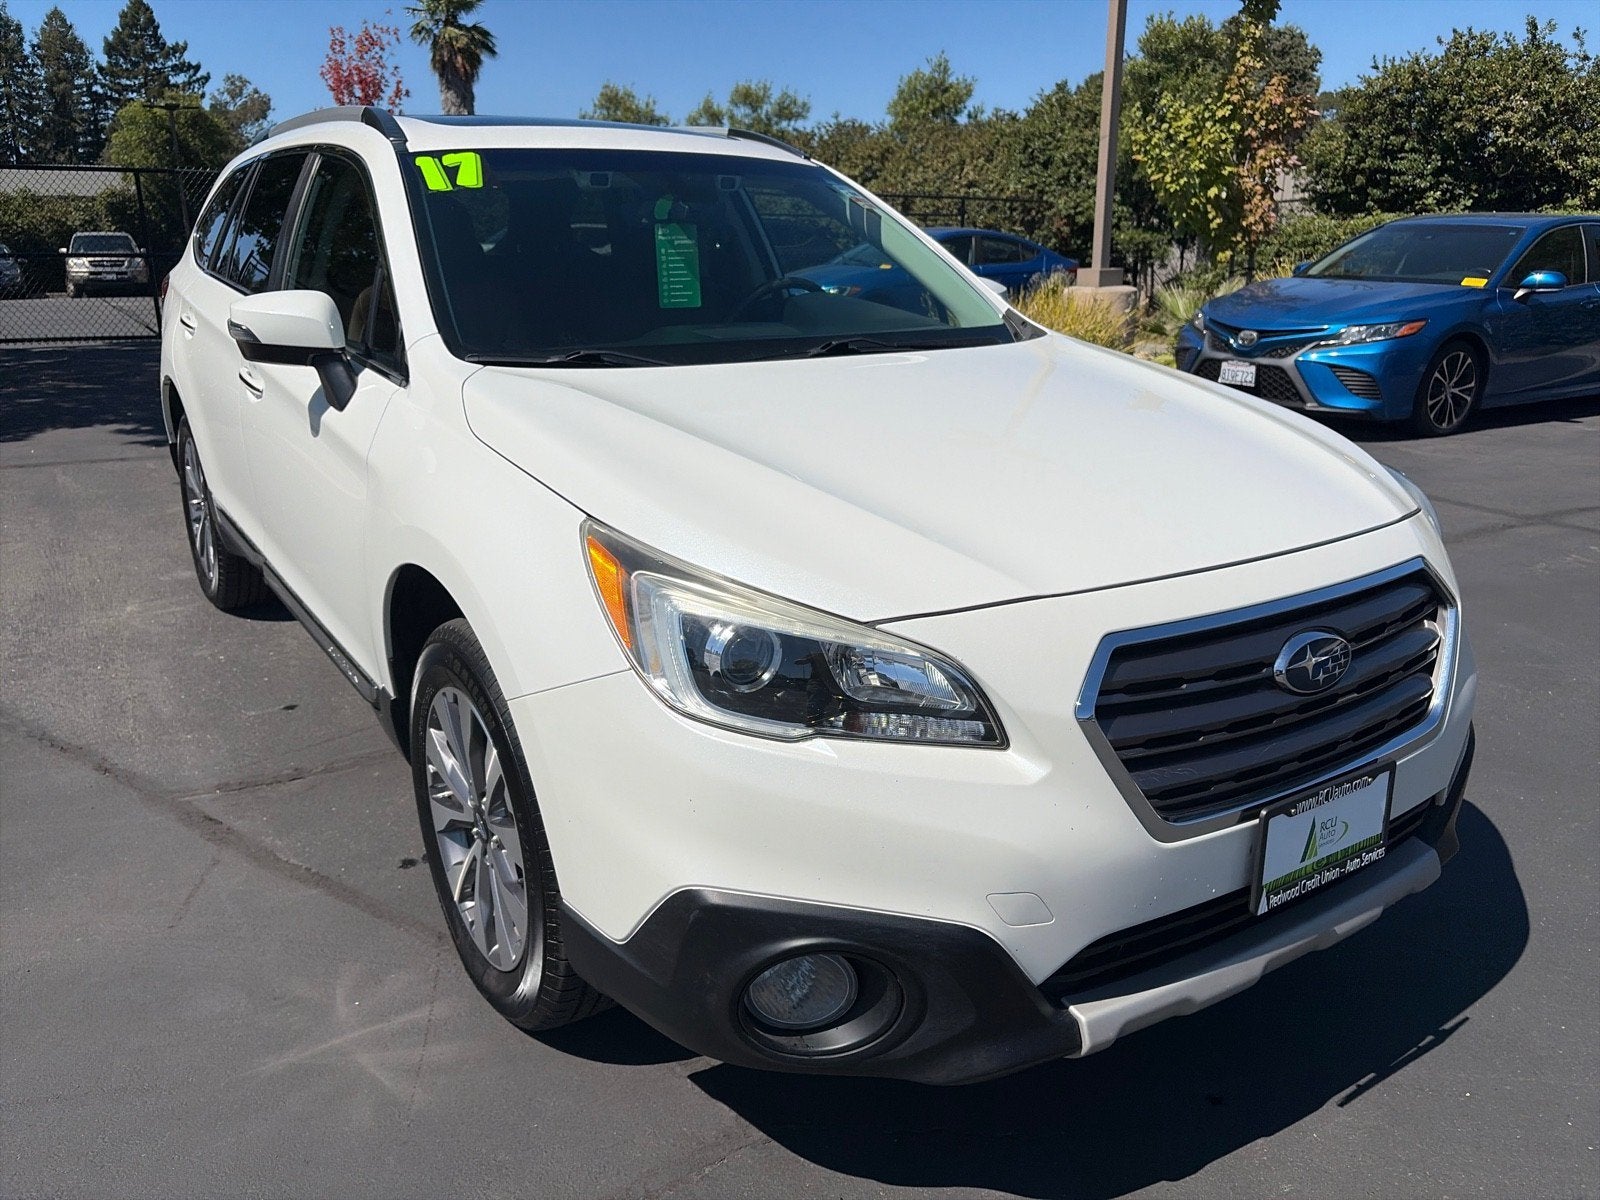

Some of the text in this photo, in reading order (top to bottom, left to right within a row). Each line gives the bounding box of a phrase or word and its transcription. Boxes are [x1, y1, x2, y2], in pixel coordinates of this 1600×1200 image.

[415, 152, 483, 191] 17
[1296, 776, 1369, 815] www.RCUauto.com
[1318, 829, 1336, 842] Auto
[1319, 816, 1338, 833] RCU
[1269, 885, 1300, 909] Redwood
[1301, 875, 1321, 894] Credit
[1321, 867, 1340, 884] Union
[1345, 859, 1361, 874] Auto
[1361, 847, 1386, 867] Services
